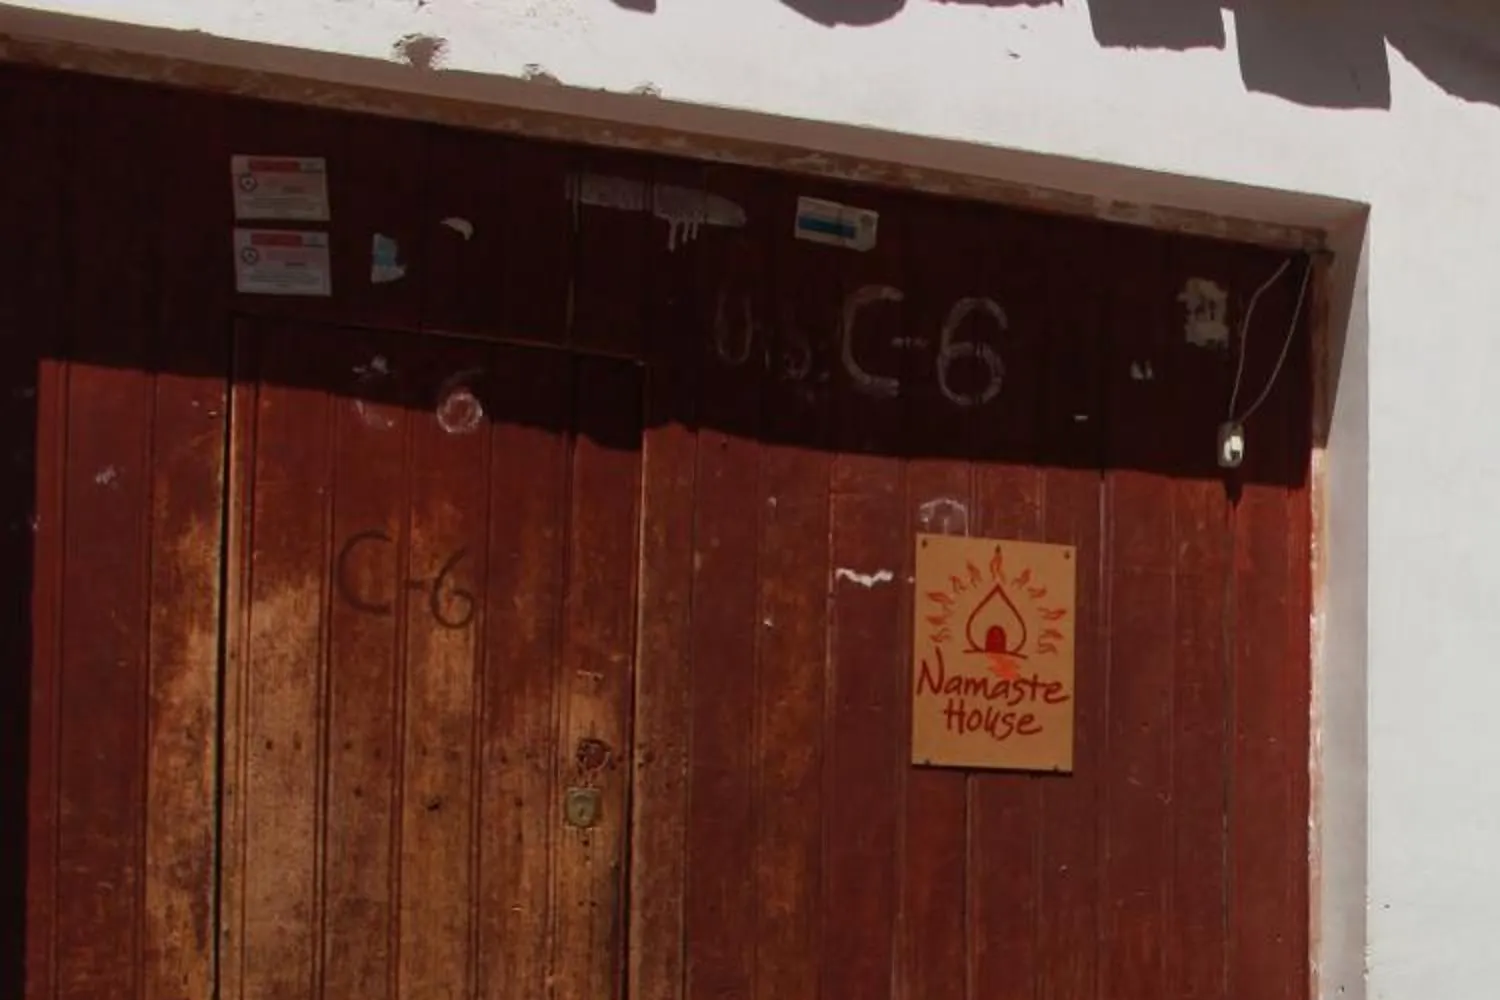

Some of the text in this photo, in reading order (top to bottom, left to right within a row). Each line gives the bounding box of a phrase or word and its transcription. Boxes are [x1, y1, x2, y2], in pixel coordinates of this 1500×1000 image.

[842, 284, 1008, 406] C-6
[336, 529, 475, 630] C-6
[916, 646, 1071, 706] Namaste
[943, 698, 1043, 741] House
